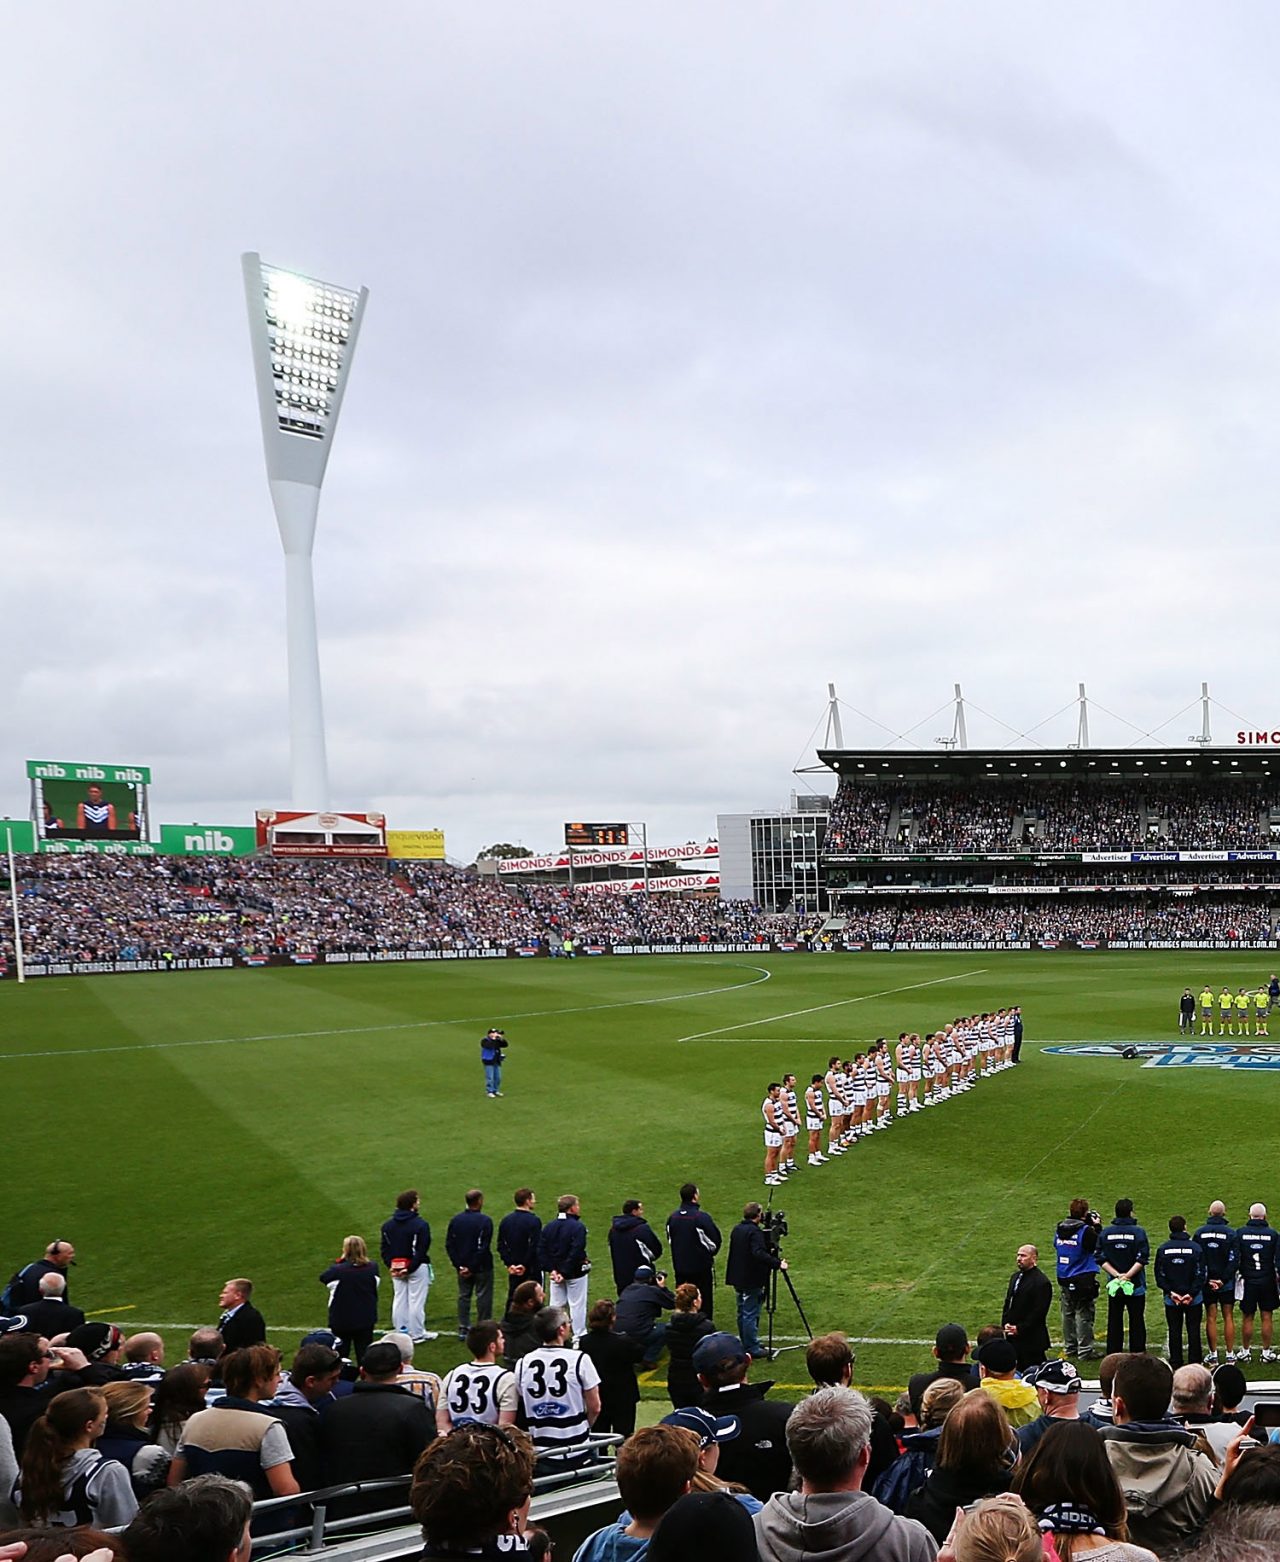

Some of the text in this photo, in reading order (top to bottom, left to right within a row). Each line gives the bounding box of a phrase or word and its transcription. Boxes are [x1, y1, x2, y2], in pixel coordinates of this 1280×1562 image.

[35, 764, 66, 777] nib
[75, 766, 105, 779] nib
[115, 768, 143, 781] nib
[185, 830, 234, 851] nib
[45, 843, 70, 853] nib
[75, 843, 99, 853] nib
[104, 844, 127, 854] nib
[132, 844, 154, 854] nib
[648, 846, 701, 860] SIMONDS
[573, 851, 627, 865] SIMONDS
[1139, 853, 1177, 861] Advertiser
[1236, 852, 1274, 860] Advertiser
[500, 858, 553, 872] SIMONDS
[576, 882, 628, 894] SIMONDS
[649, 877, 703, 890] SIMONDS
[612, 943, 770, 954] GRAND FINAL PACKAGES AVAILABLE NOW AT AFL.COM.AU
[910, 942, 940, 950] PACKAGES
[941, 942, 972, 950] AVAILABLE
[972, 942, 986, 950] NOW
[986, 942, 995, 950] AT
[995, 942, 1031, 950] AFL.COM.AU
[1107, 940, 1277, 949] GRAND FINAL PACKAGES AVAILABLE NOW AT AFL.COM.AU
[325, 952, 349, 962] GRAND
[350, 952, 370, 962] FINAL
[406, 949, 441, 960] AVAILABLE
[442, 949, 458, 959] NOW
[458, 948, 467, 958] AT
[468, 948, 507, 957] AFL.COM.AU
[48, 963, 72, 974] FINAL
[73, 962, 114, 973] PACKAGES
[115, 960, 158, 971] AVAILABLE
[177, 959, 187, 969] AT
[188, 957, 233, 968] AFL.COM.AU
[527, 1358, 568, 1398] 33
[450, 1374, 490, 1414] 33
[535, 1404, 561, 1415] Ford
